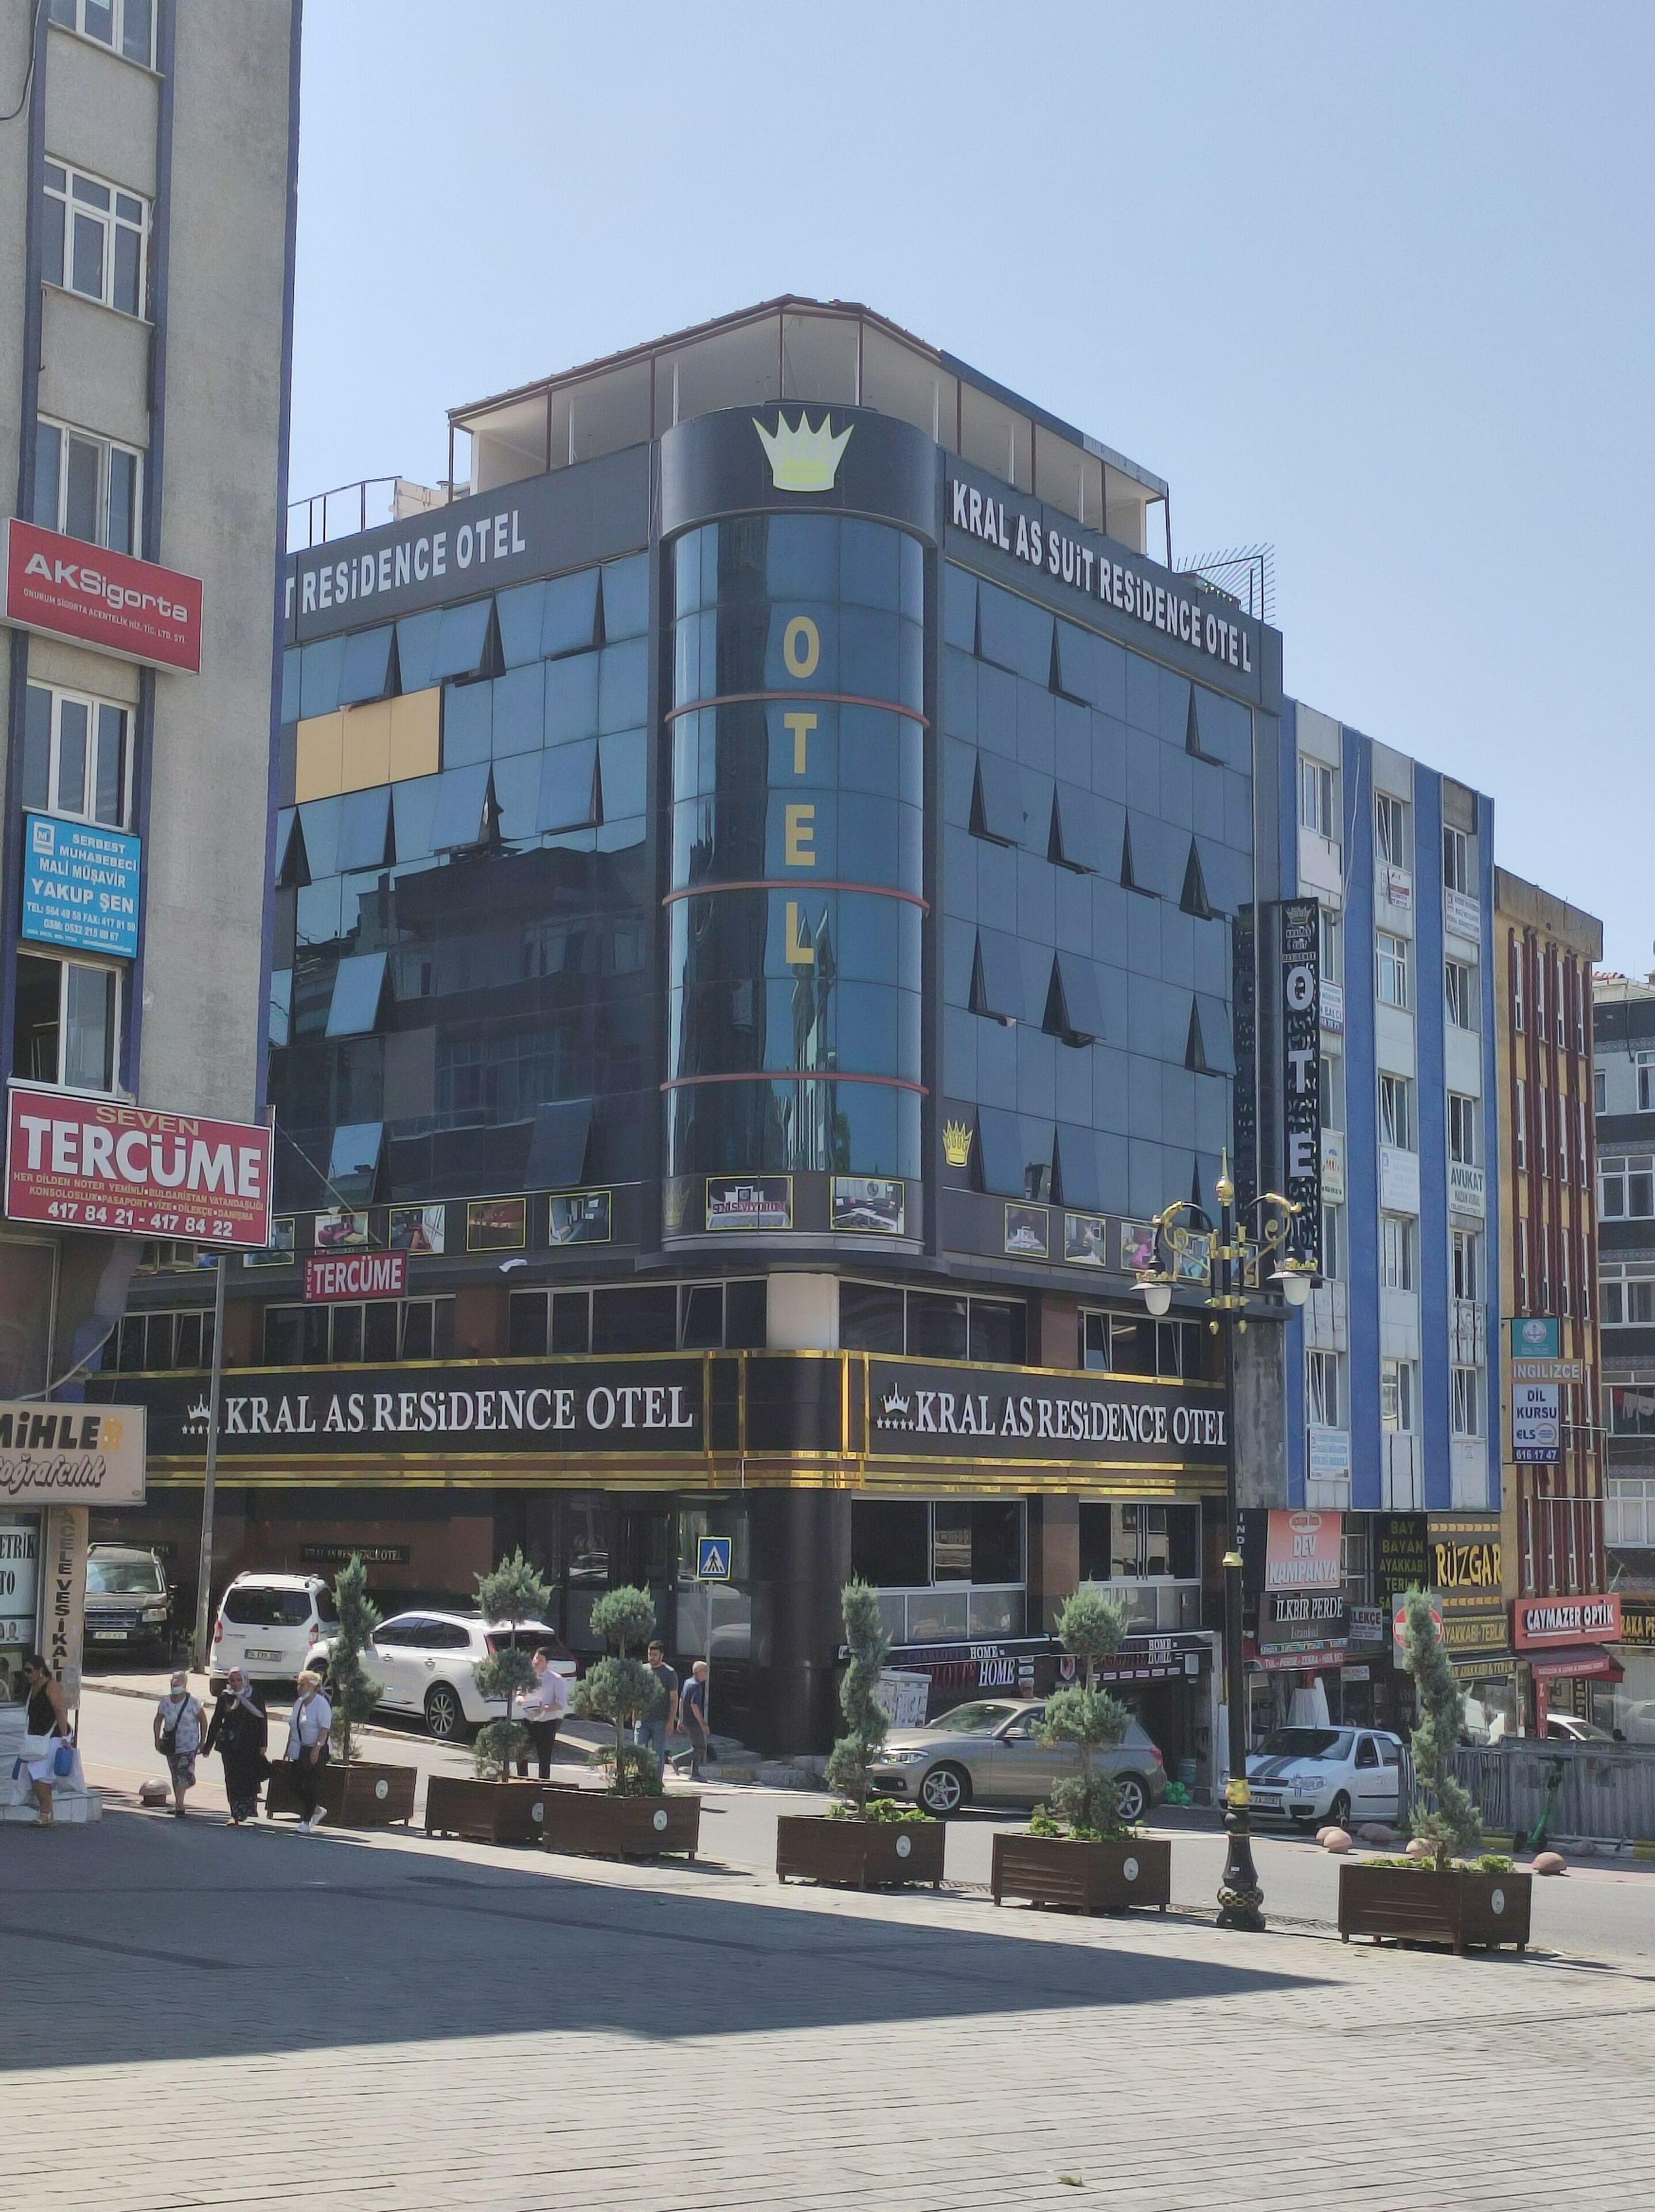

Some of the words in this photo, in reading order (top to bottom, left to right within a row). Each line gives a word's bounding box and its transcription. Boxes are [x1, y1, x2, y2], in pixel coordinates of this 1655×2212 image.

[456, 509, 525, 569] OTEL
[953, 479, 1009, 551] KRAL
[1016, 514, 1043, 566] AS
[1205, 613, 1252, 673] OTEL
[783, 615, 820, 964] OTEL
[72, 834, 126, 854] SERBEST
[72, 863, 126, 889] MÜŞAVİR
[31, 877, 94, 905] YAKUP
[99, 893, 134, 915] ŞEN
[96, 1106, 199, 1137] SEVEN
[20, 1115, 262, 1199] TERCÜME
[14, 1172, 33, 1183] HER
[36, 1172, 70, 1187] DİLDEN
[74, 1179, 105, 1191] NOTER
[1451, 1166, 1483, 1193] AVUKAT
[48, 1201, 78, 1219] 417
[85, 1205, 107, 1223] 84
[115, 1208, 134, 1226] 21
[150, 1213, 179, 1231] 417
[185, 1217, 206, 1234] 84
[212, 1220, 233, 1237] 22
[313, 1255, 403, 1294] TERCÜME
[1513, 1361, 1580, 1379] İNGİLİZCE
[1527, 1387, 1546, 1402] DİL
[225, 1395, 316, 1434] KRAL
[323, 1393, 365, 1433] AS
[586, 1386, 693, 1430] OTEL
[915, 1390, 996, 1435] KRAL
[1000, 1396, 1034, 1438] AS
[1516, 1407, 1557, 1419] KURSU
[1391, 1521, 1414, 1535] BAY
[1293, 1535, 1317, 1557] DEV
[1382, 1539, 1424, 1554] BAYAN
[1268, 1560, 1337, 1585] KAMPANYA
[1379, 1557, 1426, 1573] AYAKKABI
[1435, 1540, 1502, 1588] RÜZGAR
[1311, 1596, 1343, 1620] PERDE
[969, 1645, 998, 1660] HOME
[1148, 1638, 1172, 1651] HOME
[978, 1658, 1016, 1687] HOME
